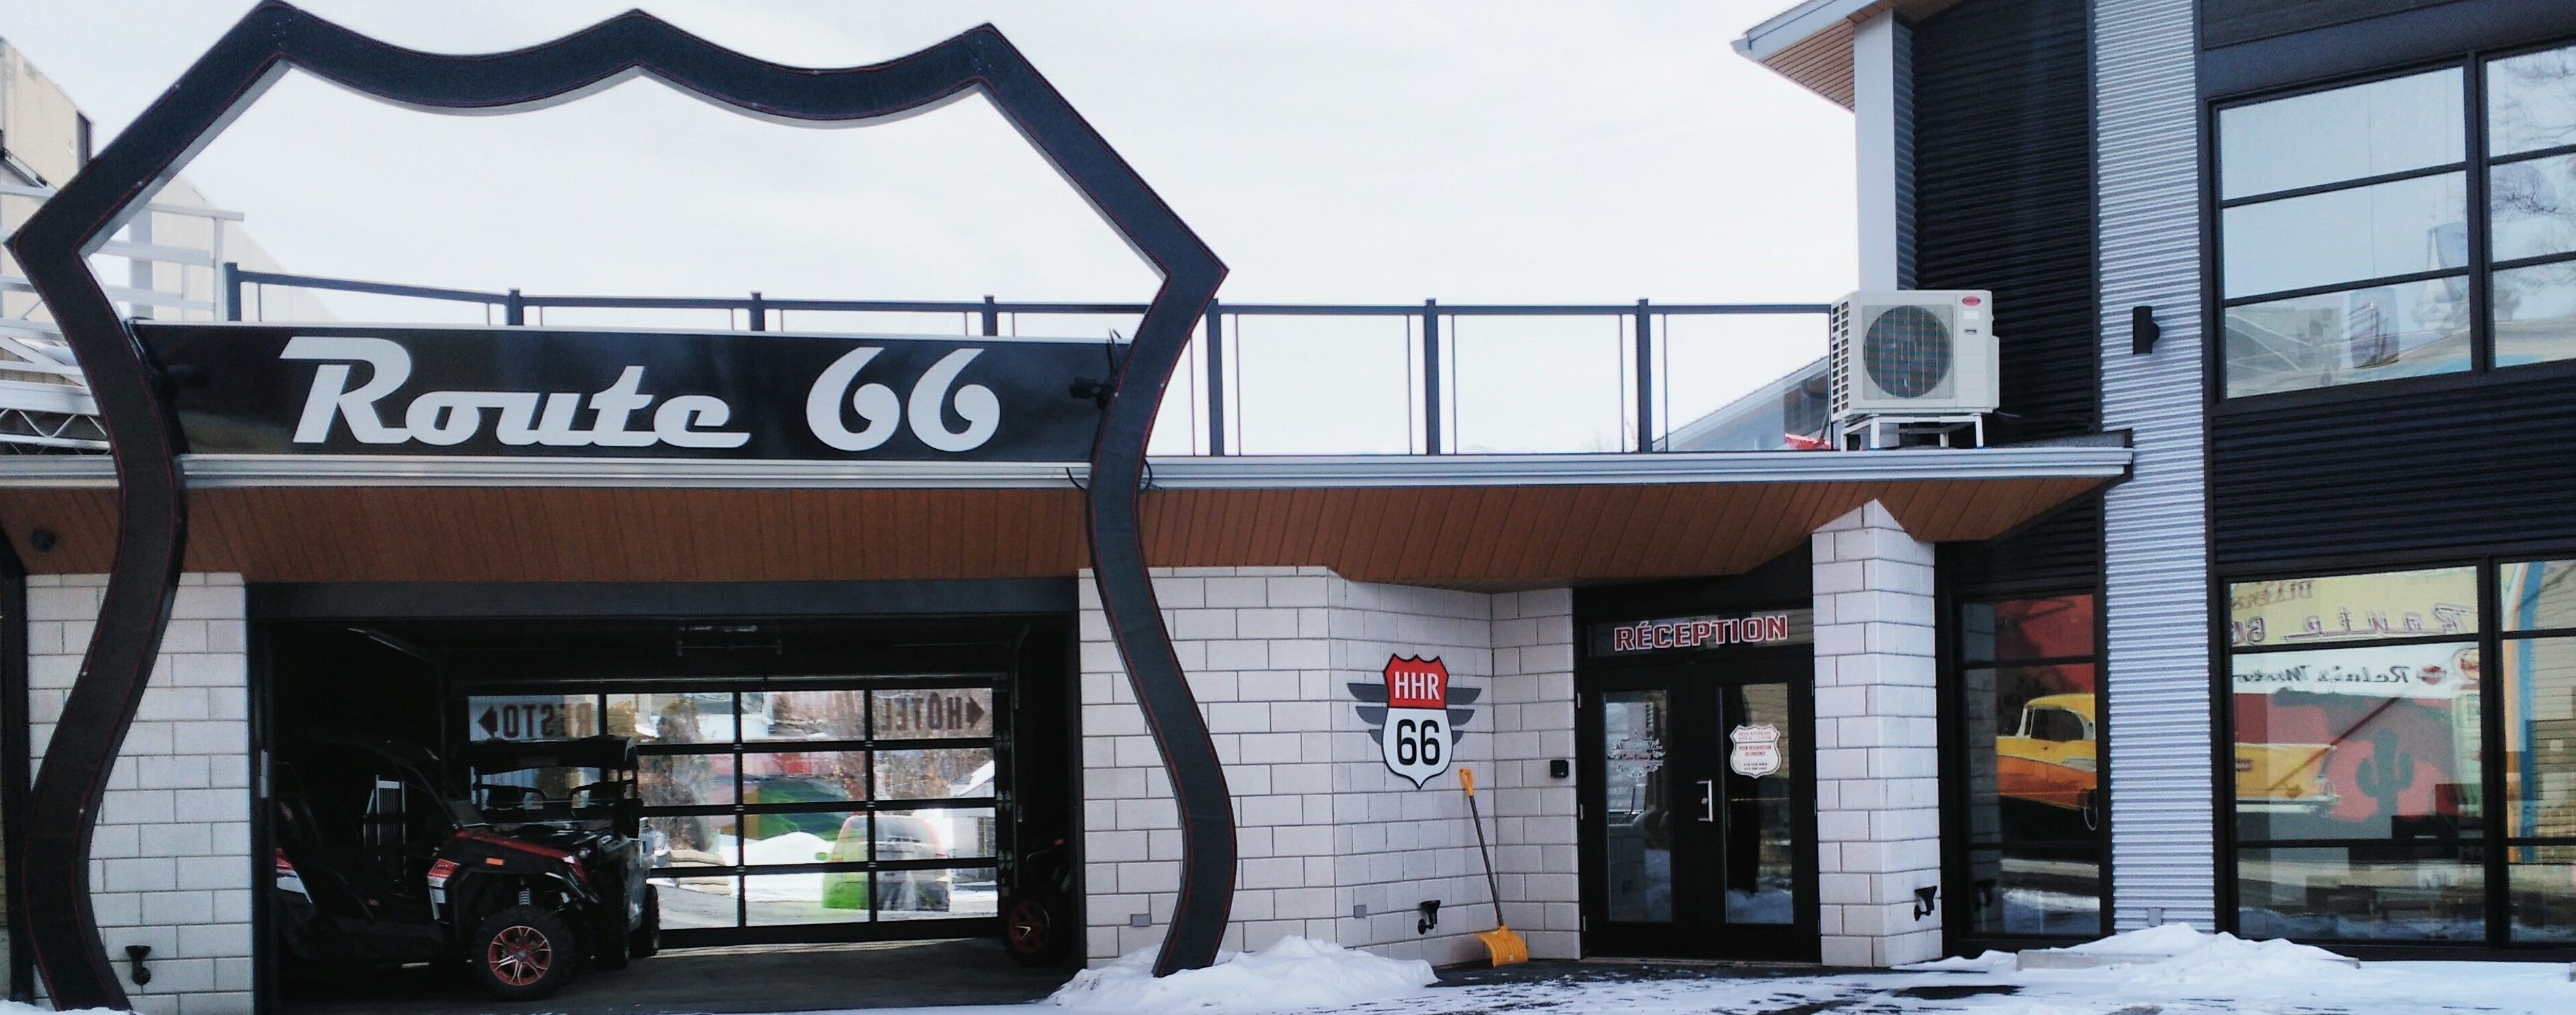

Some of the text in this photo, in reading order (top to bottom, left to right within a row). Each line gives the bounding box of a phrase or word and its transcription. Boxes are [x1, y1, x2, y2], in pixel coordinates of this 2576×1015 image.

[279, 336, 1000, 452] Route 66
[1614, 615, 1789, 651] RÉCEPTION
[1394, 671, 1440, 700] HHR
[1397, 719, 1440, 765] 66
